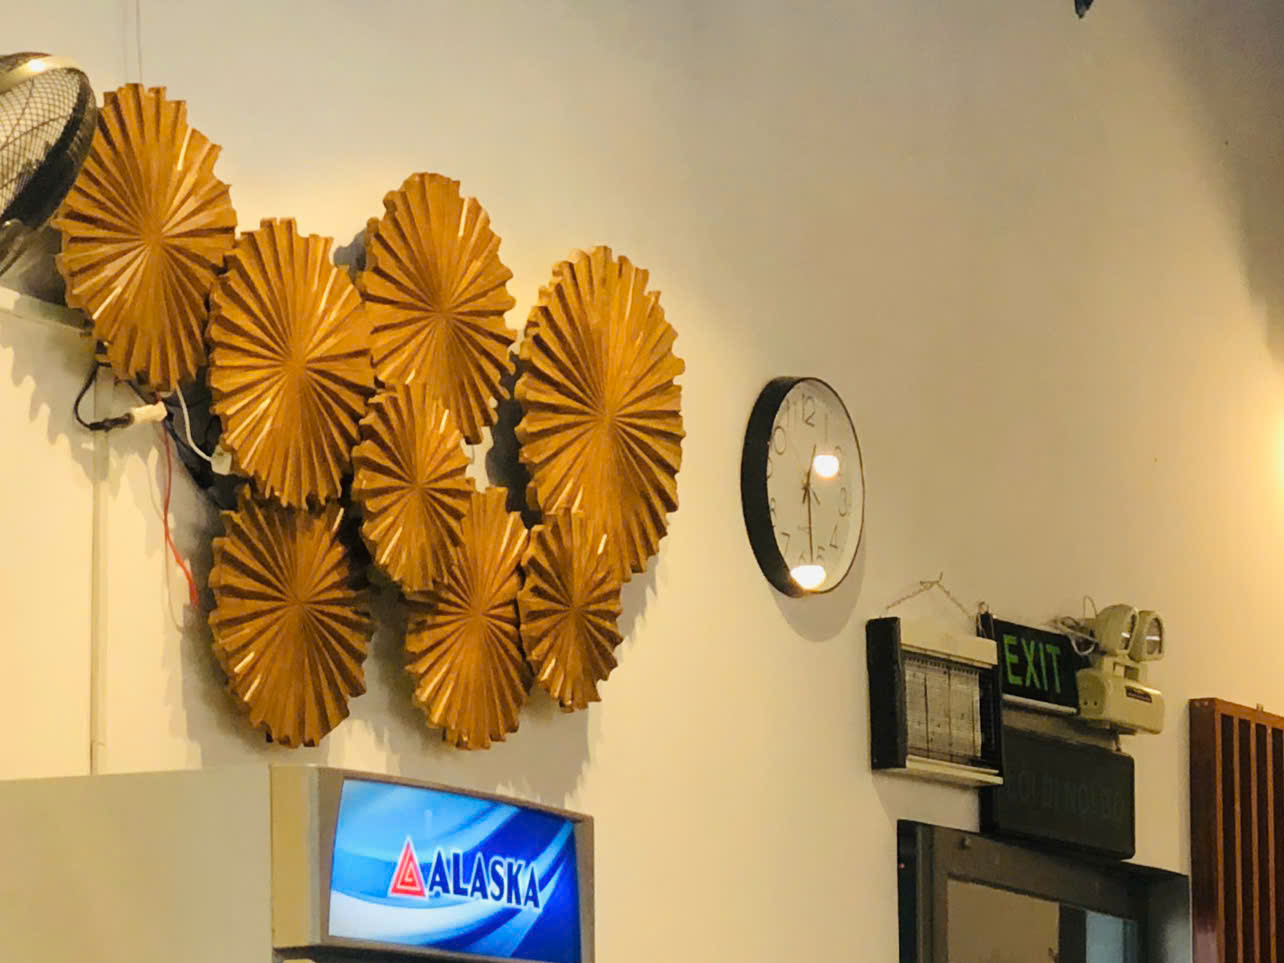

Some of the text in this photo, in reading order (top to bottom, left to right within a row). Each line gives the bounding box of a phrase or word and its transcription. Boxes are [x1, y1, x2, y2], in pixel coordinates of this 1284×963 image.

[801, 393, 816, 428] 12
[779, 530, 791, 557] 7
[1002, 634, 1061, 694] EXIT
[428, 848, 541, 909] ALASKA
